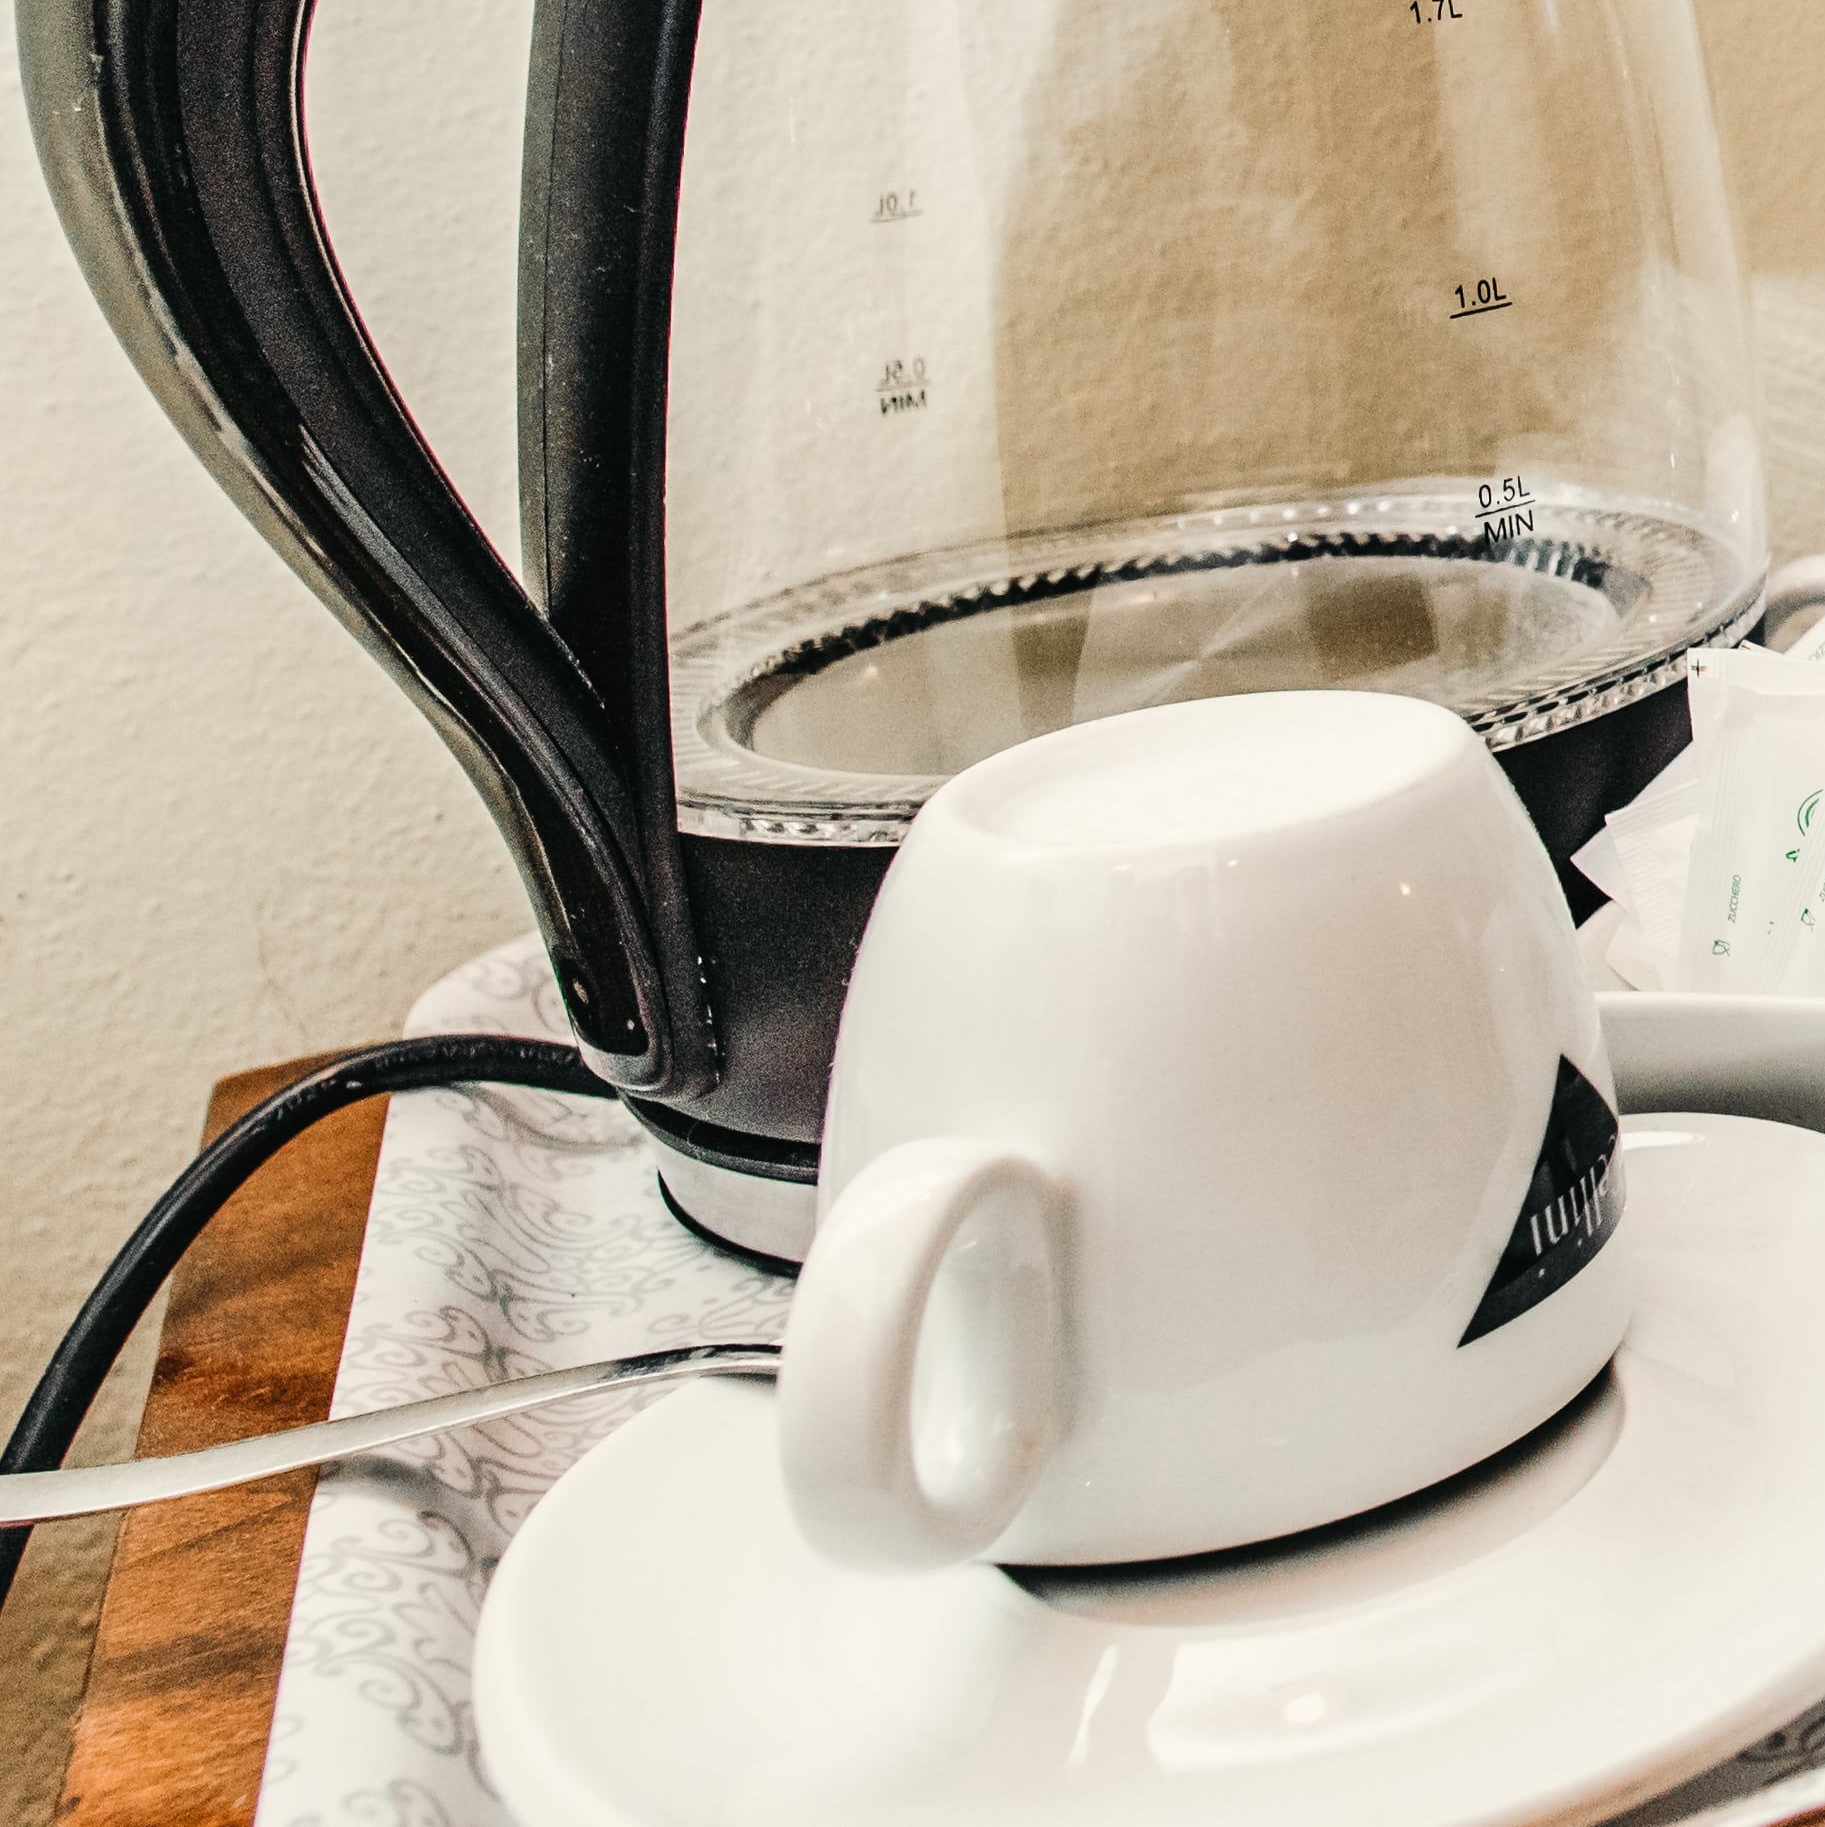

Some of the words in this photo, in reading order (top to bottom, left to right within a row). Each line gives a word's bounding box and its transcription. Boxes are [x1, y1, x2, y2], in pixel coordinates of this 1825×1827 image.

[1454, 277, 1507, 309] 1.0L
[1478, 475, 1531, 509] 0.5L
[1484, 509, 1534, 546] MIN
